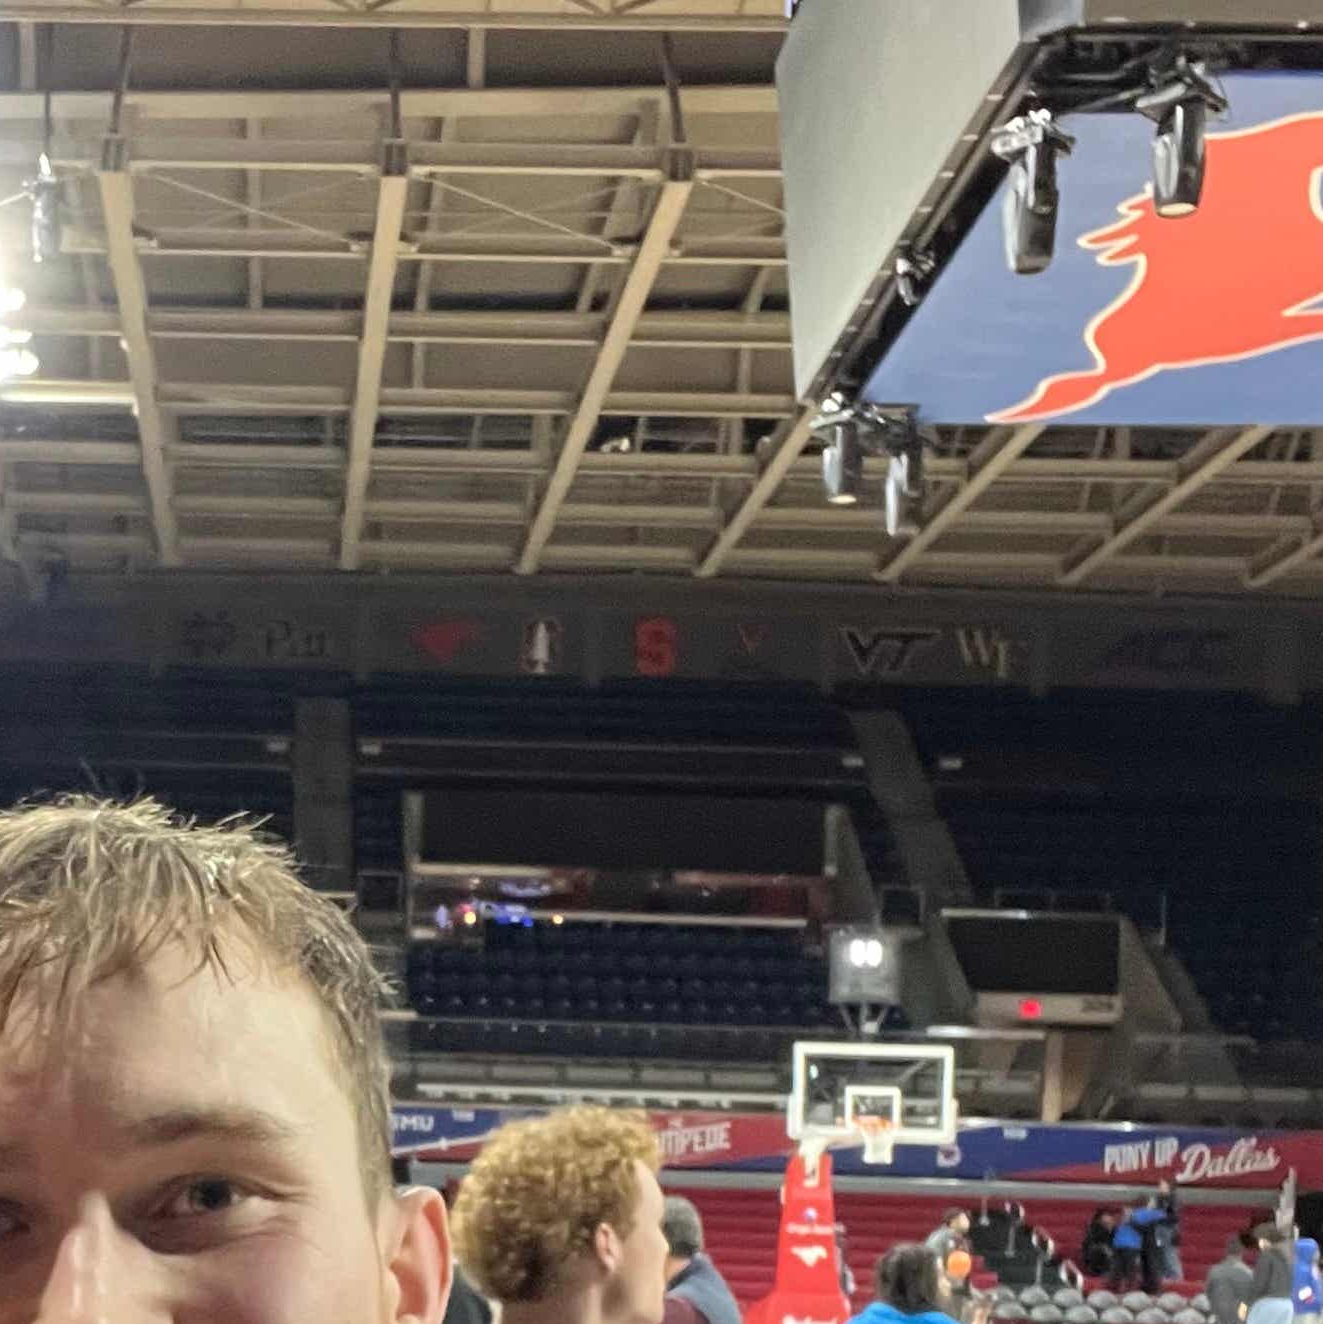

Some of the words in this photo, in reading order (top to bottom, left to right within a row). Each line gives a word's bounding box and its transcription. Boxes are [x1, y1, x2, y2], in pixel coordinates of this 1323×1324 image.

[838, 625, 940, 674] VT
[1104, 1141, 1151, 1174] PONY
[1154, 1136, 1179, 1168] UP
[1176, 1136, 1280, 1183] Dallas
